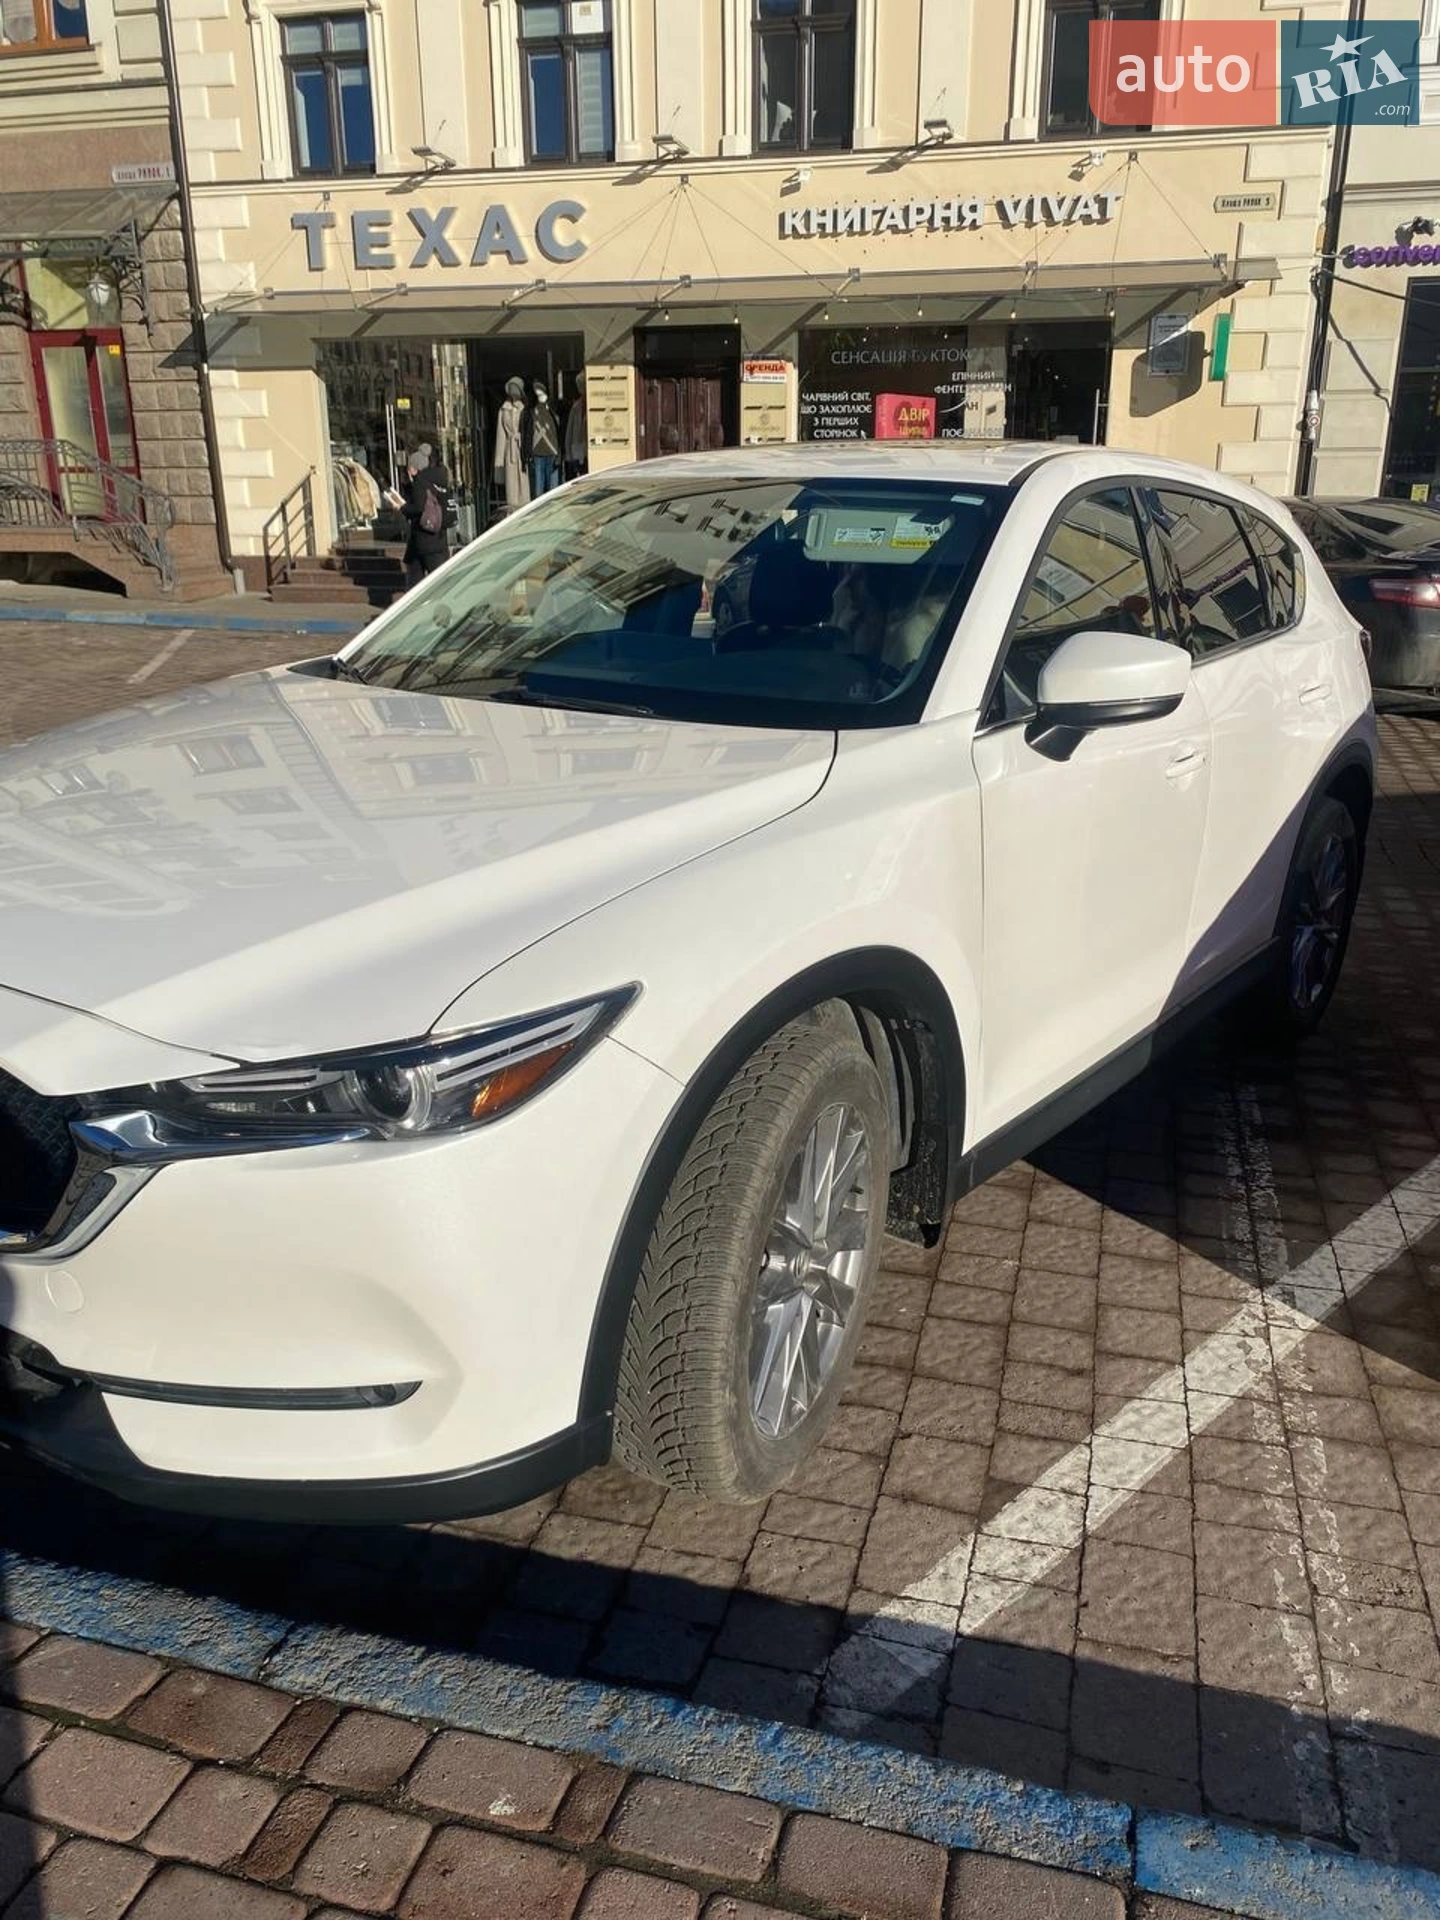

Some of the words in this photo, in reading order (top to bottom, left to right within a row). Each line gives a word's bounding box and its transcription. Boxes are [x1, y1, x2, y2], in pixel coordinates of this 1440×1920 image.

[782, 197, 985, 235] КНИГАРНЯ
[998, 192, 1122, 226] VIVAT
[291, 200, 588, 271] ТЕХАС
[831, 350, 907, 364] СЕНСАЦІЯ
[745, 364, 785, 372] ОРЕНДА
[819, 404, 873, 414] ЗАХОПЛЮЄ
[898, 407, 930, 421] ДВІР
[821, 416, 859, 426] ПЕРШИХ
[813, 428, 858, 438] СТОРІНОК
